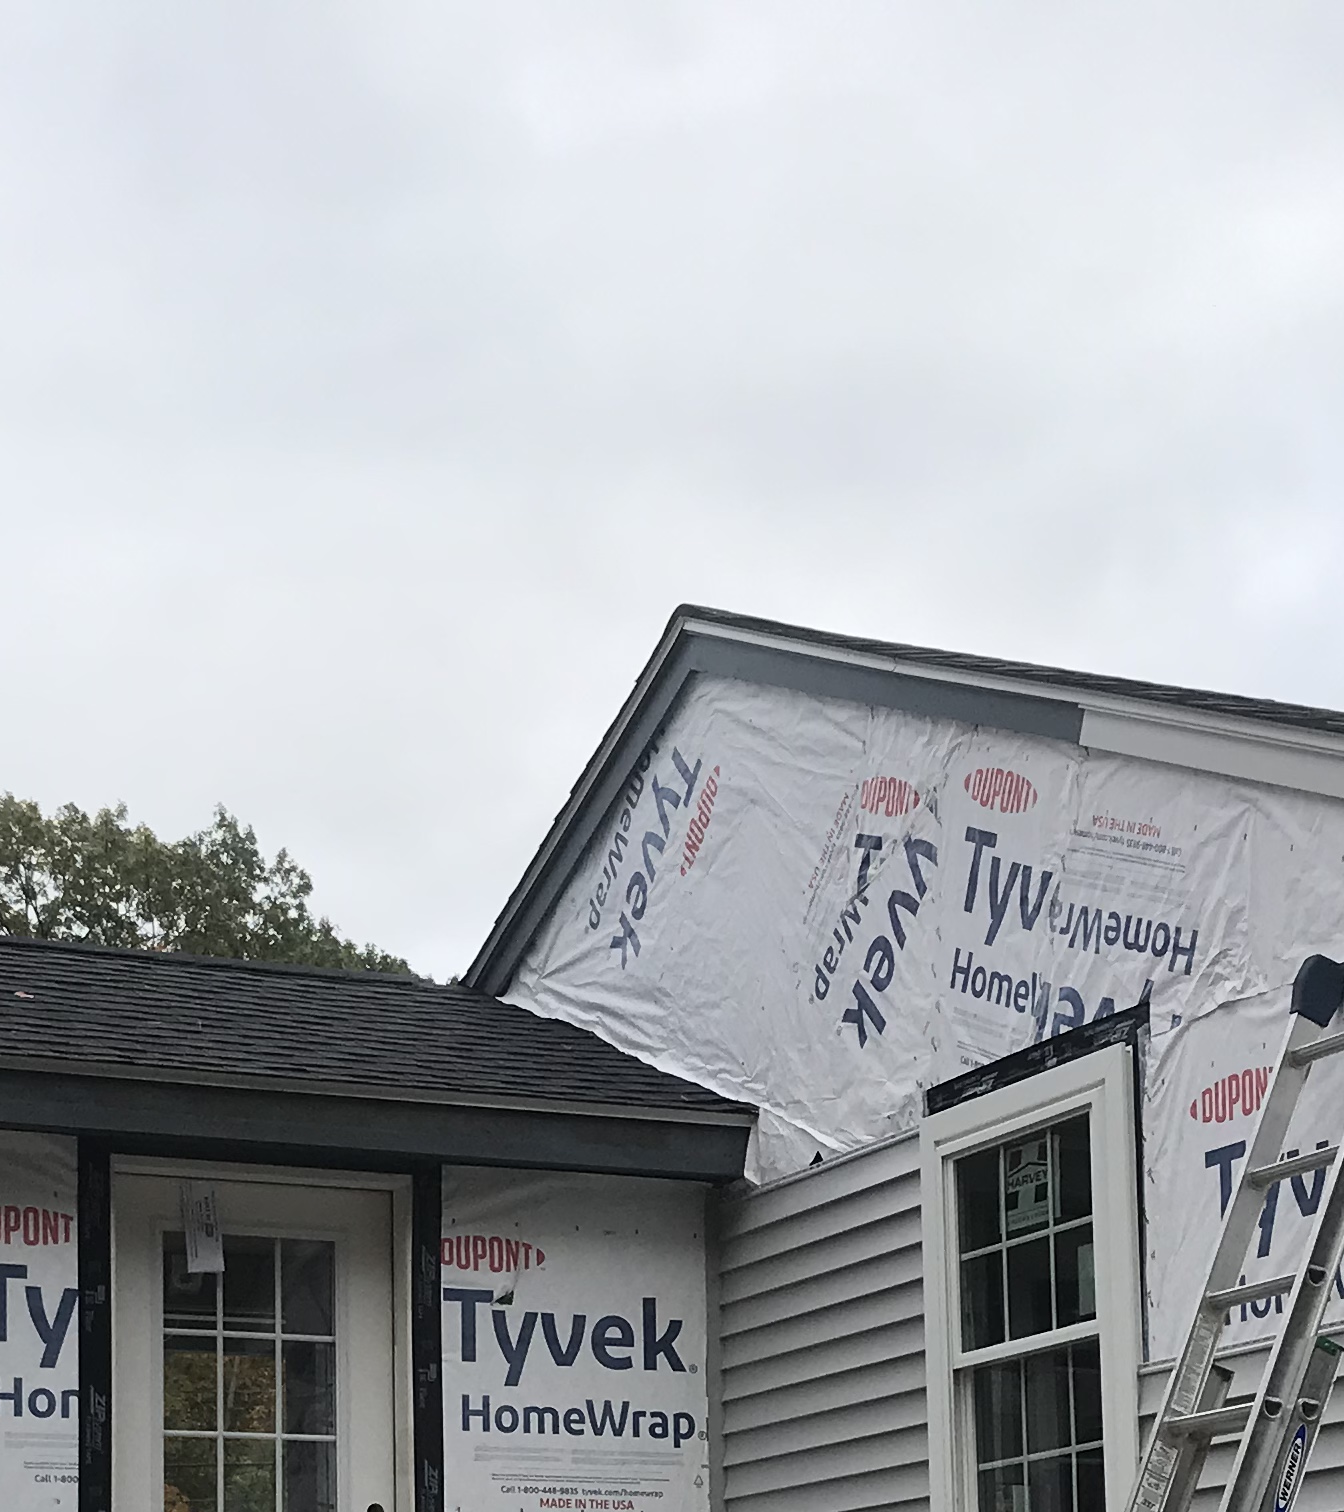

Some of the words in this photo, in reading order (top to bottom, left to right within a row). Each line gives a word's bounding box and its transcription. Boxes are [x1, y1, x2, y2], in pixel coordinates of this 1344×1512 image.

[971, 767, 1032, 813] DUPONT
[683, 776, 720, 870] DUPONT
[1092, 814, 1108, 828] USA
[1110, 818, 1126, 831] THE
[1126, 821, 1136, 833] IN
[1137, 822, 1161, 838] MADE
[609, 746, 703, 970] Tyvek
[1201, 1066, 1274, 1123] DUPON
[1007, 1169, 1048, 1189] HARVEY
[442, 1235, 533, 1273] DUPONT
[443, 1287, 688, 1386] Tyvek
[461, 1394, 695, 1448] HomeWrap
[35, 1473, 52, 1483] Call
[1278, 1442, 1302, 1502] WERNER
[540, 1497, 572, 1509] MADE
[575, 1498, 586, 1509] IN
[589, 1499, 610, 1510] THE
[612, 1499, 635, 1511] USA
